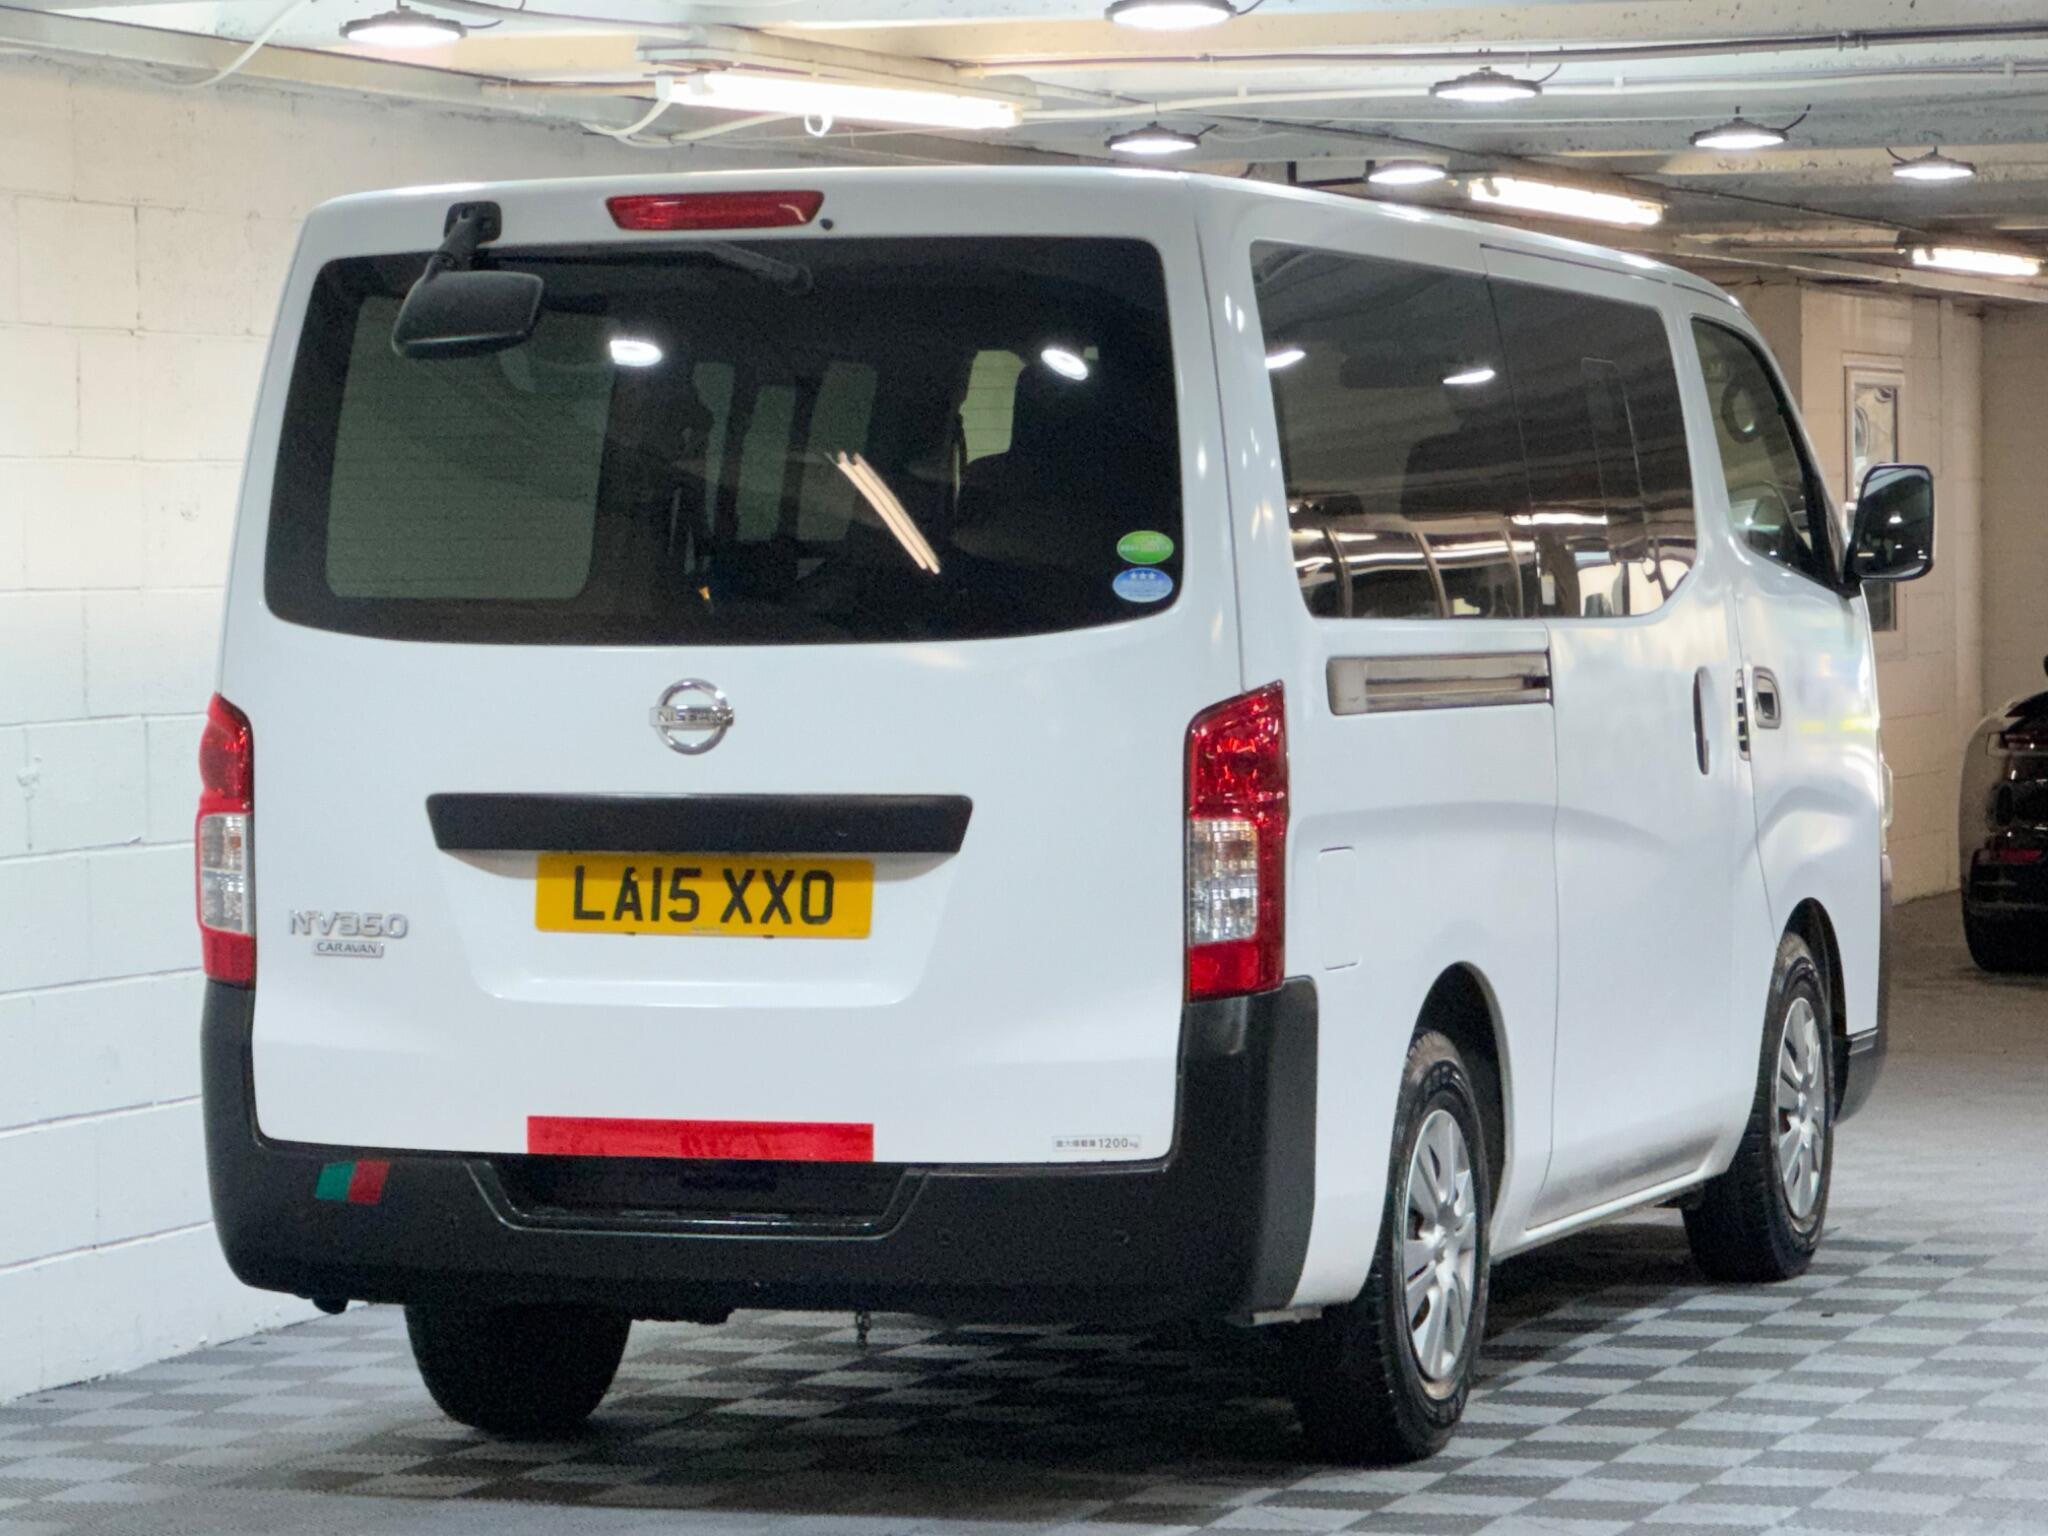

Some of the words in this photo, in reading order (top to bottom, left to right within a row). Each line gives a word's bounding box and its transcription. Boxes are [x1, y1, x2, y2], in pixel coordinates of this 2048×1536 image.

[573, 865, 702, 922] LA15
[720, 868, 834, 925] XXO
[289, 911, 408, 939] NV350
[316, 942, 378, 954] CARAVAN
